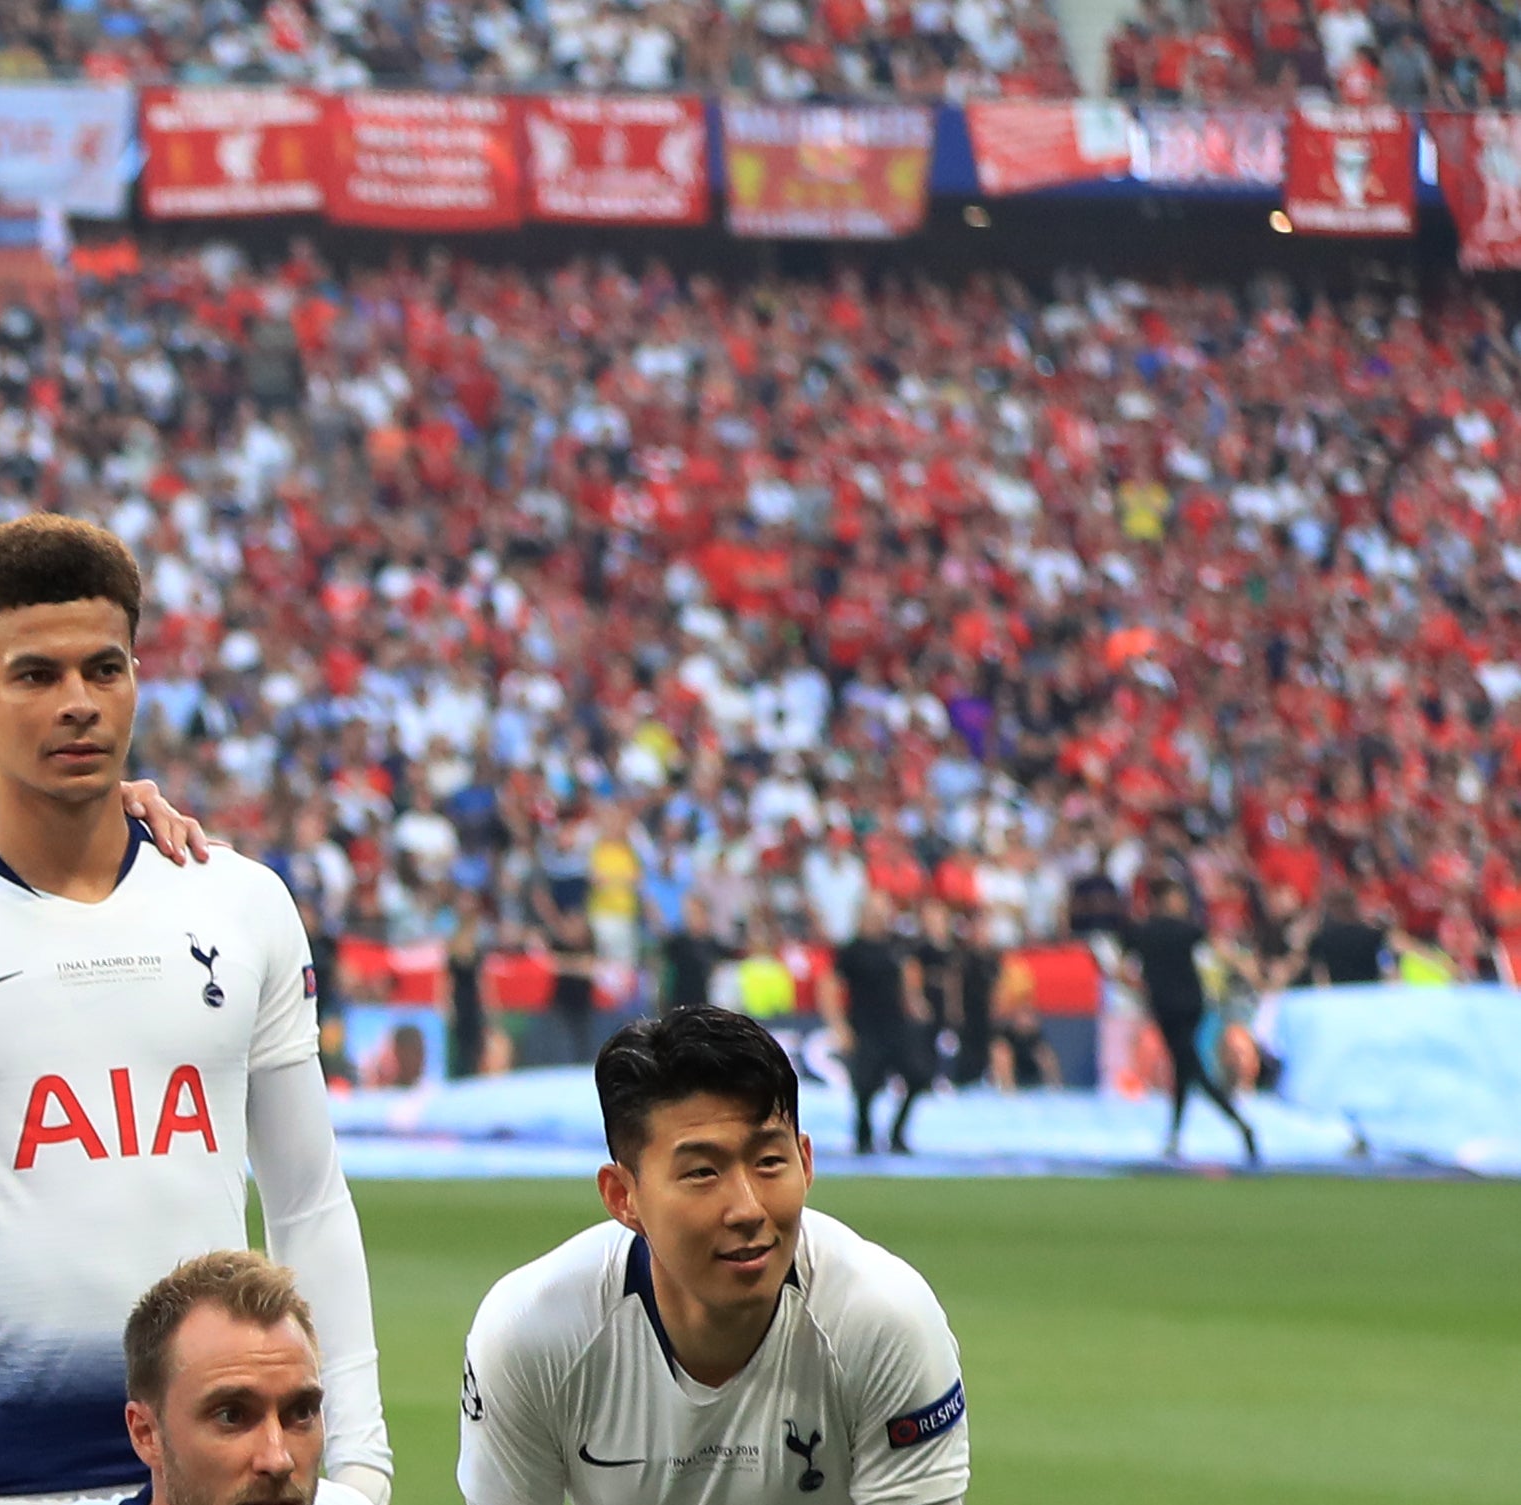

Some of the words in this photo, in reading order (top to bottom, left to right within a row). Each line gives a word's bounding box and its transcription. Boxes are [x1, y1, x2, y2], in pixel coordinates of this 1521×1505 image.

[90, 956, 134, 968] MADRID
[138, 955, 161, 966] 2019
[14, 1064, 219, 1171] AIA
[736, 1445, 759, 1457] 2019
